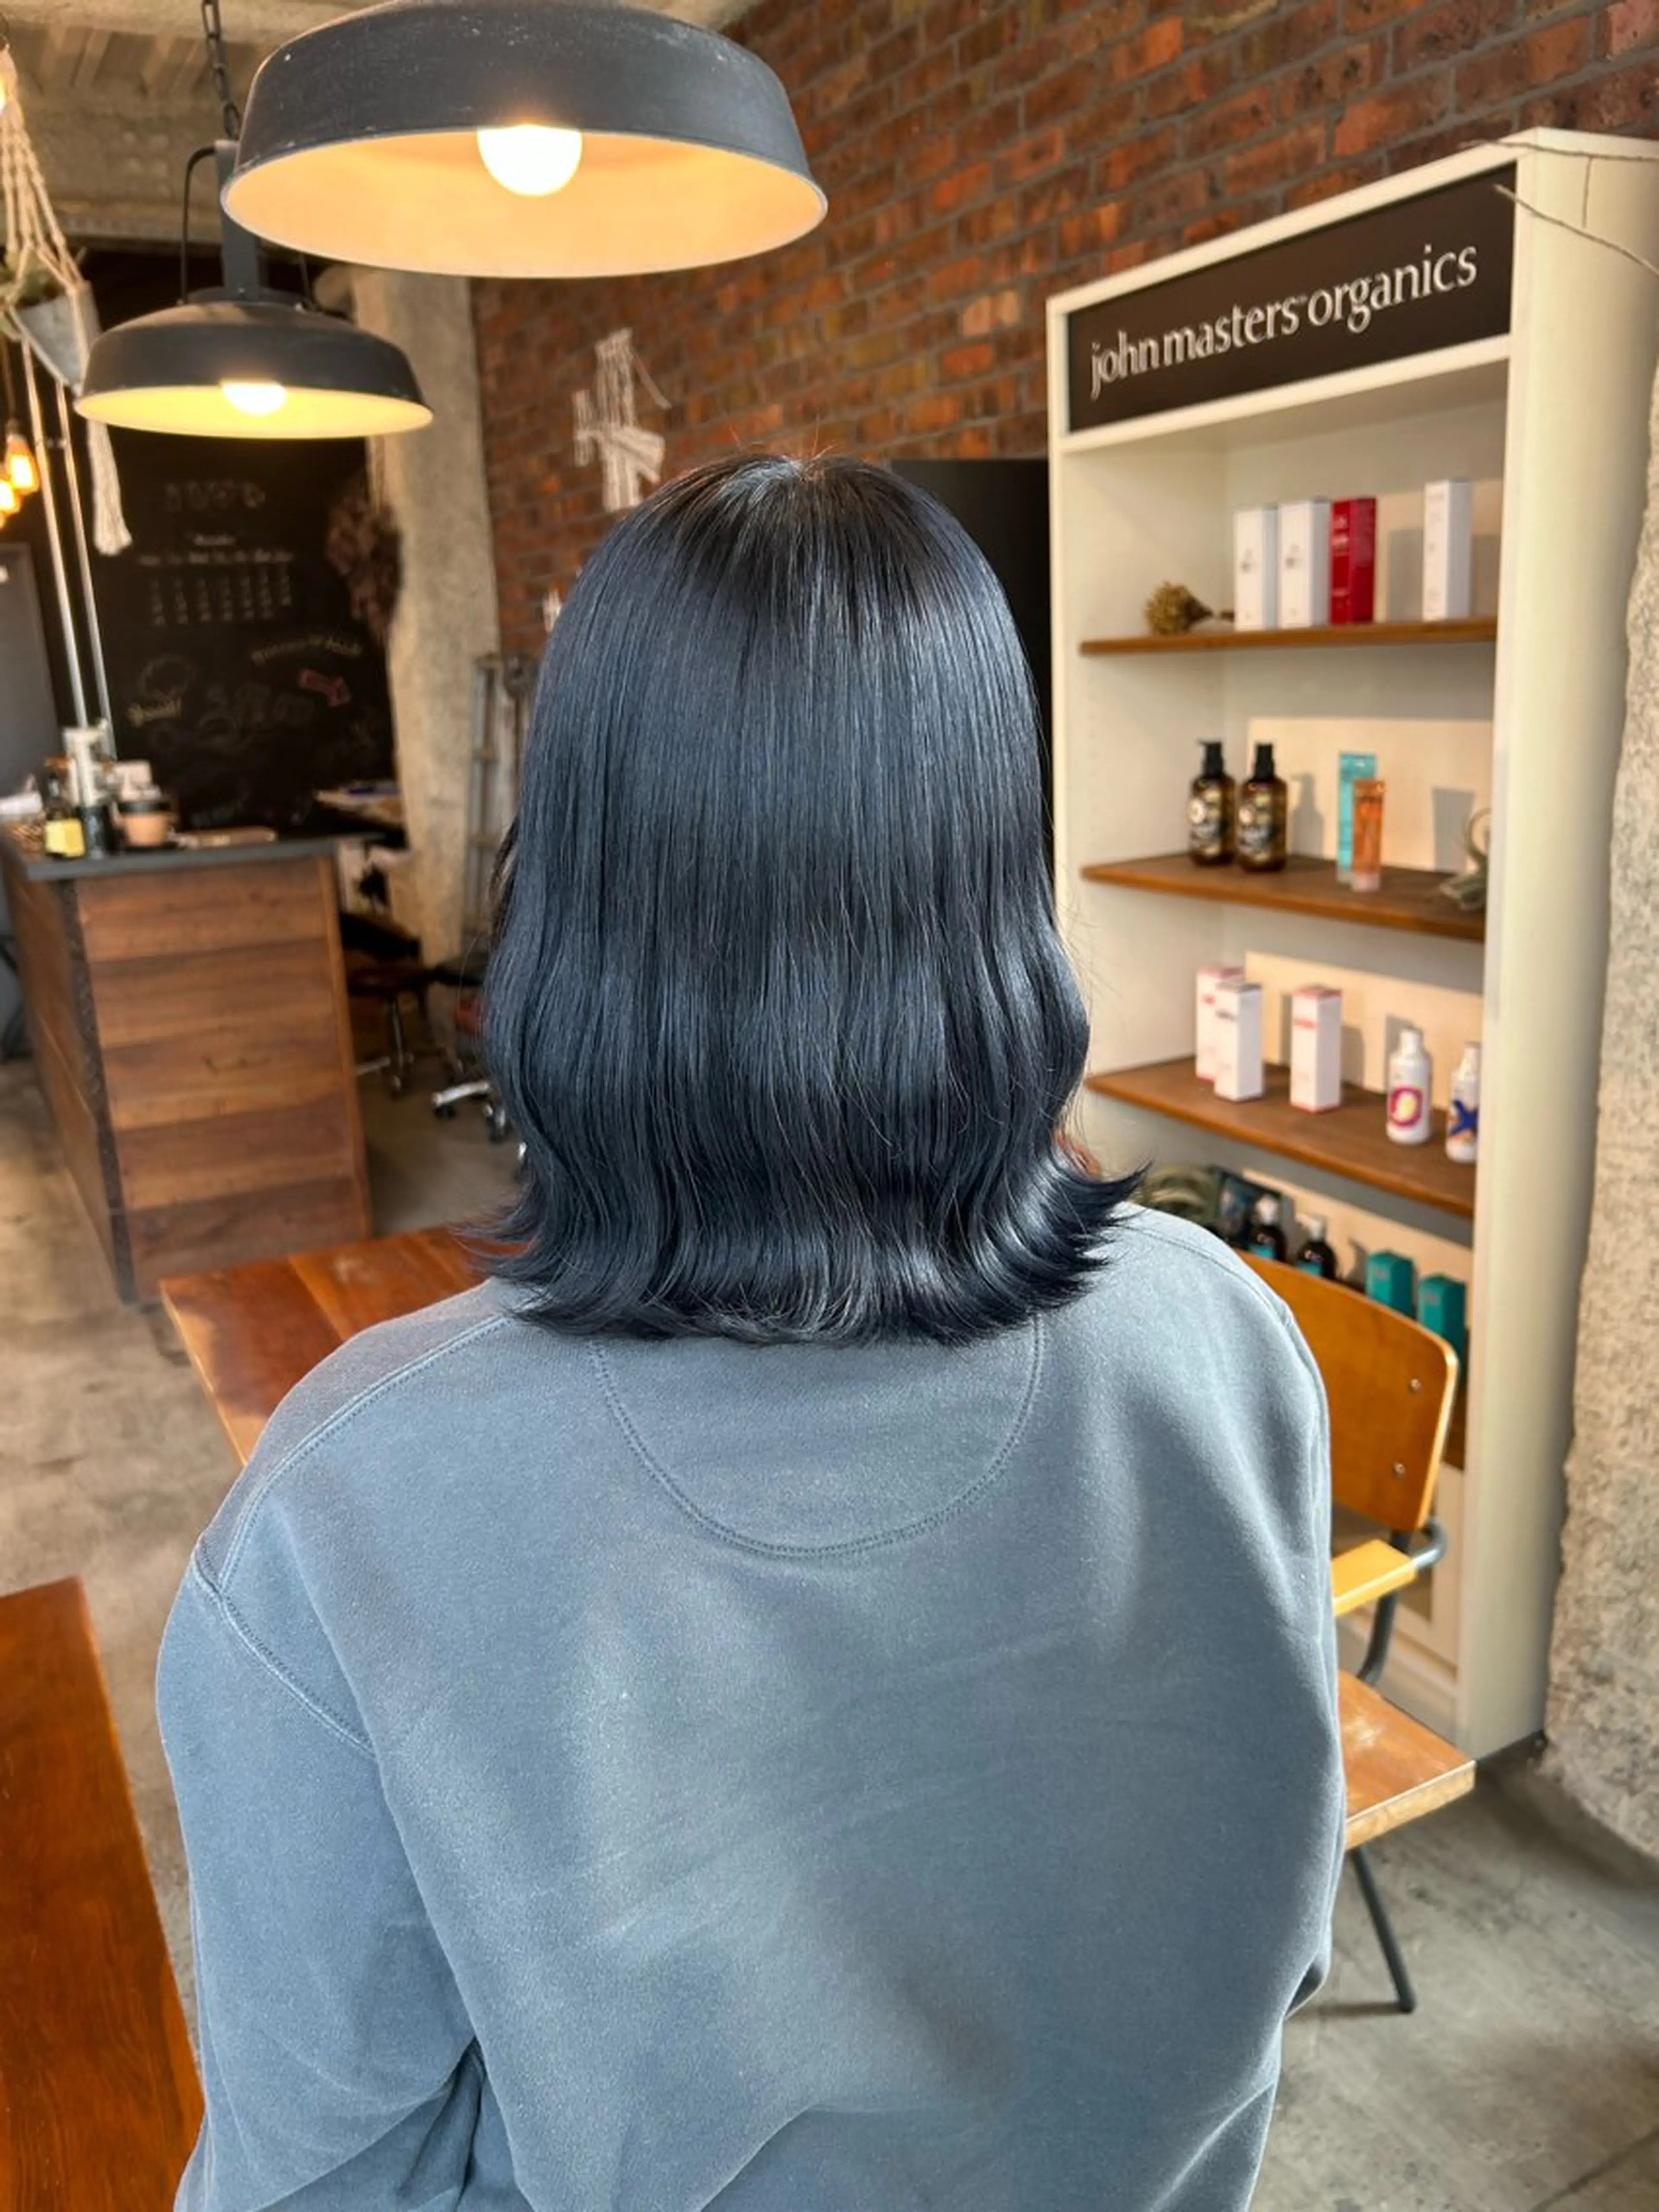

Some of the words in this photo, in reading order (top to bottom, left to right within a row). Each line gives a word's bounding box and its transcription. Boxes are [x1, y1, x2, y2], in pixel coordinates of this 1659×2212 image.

[1090, 328, 1160, 401] john
[1163, 295, 1300, 366] masters
[1307, 244, 1477, 333] organics
